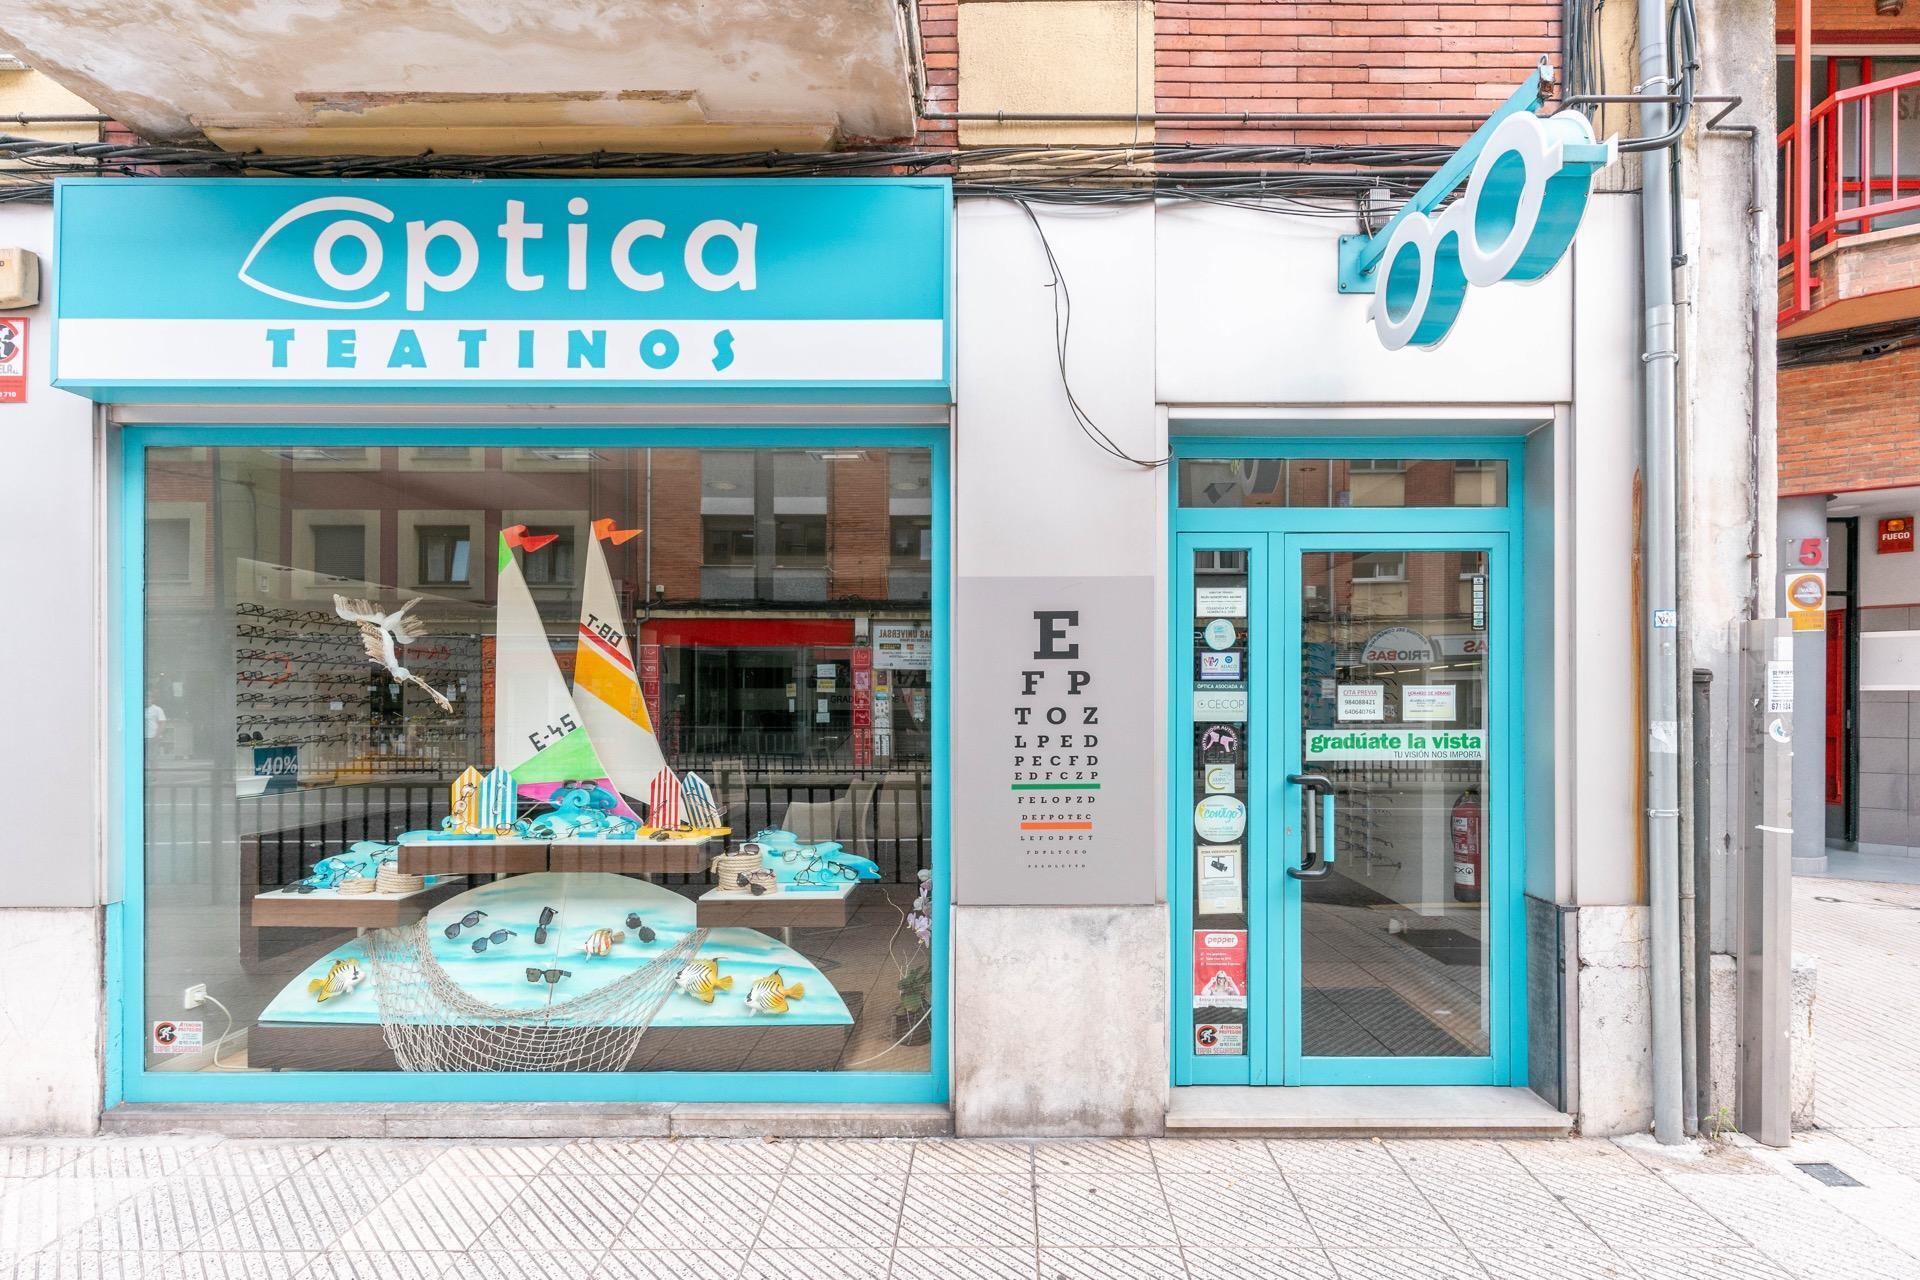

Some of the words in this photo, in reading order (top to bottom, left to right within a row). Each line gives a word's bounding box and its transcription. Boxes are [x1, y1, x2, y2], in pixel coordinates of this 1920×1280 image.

[265, 328, 736, 373] TEATINOS
[1882, 532, 1910, 541] FUEGO
[1799, 538, 1822, 566] 5
[586, 613, 623, 648] T-80
[1033, 611, 1079, 660] E
[1207, 699, 1245, 709] CECOP
[528, 713, 577, 752] E-45
[1310, 732, 1401, 752] gradúate
[1408, 733, 1426, 749] la
[1432, 733, 1481, 749] vista
[1394, 751, 1403, 759] TU
[1404, 750, 1430, 759] VISIÓN
[1431, 751, 1448, 759] NOS
[1449, 751, 1482, 759] IMPORTA
[255, 755, 298, 776] -40%
[1207, 936, 1236, 944] pepper
